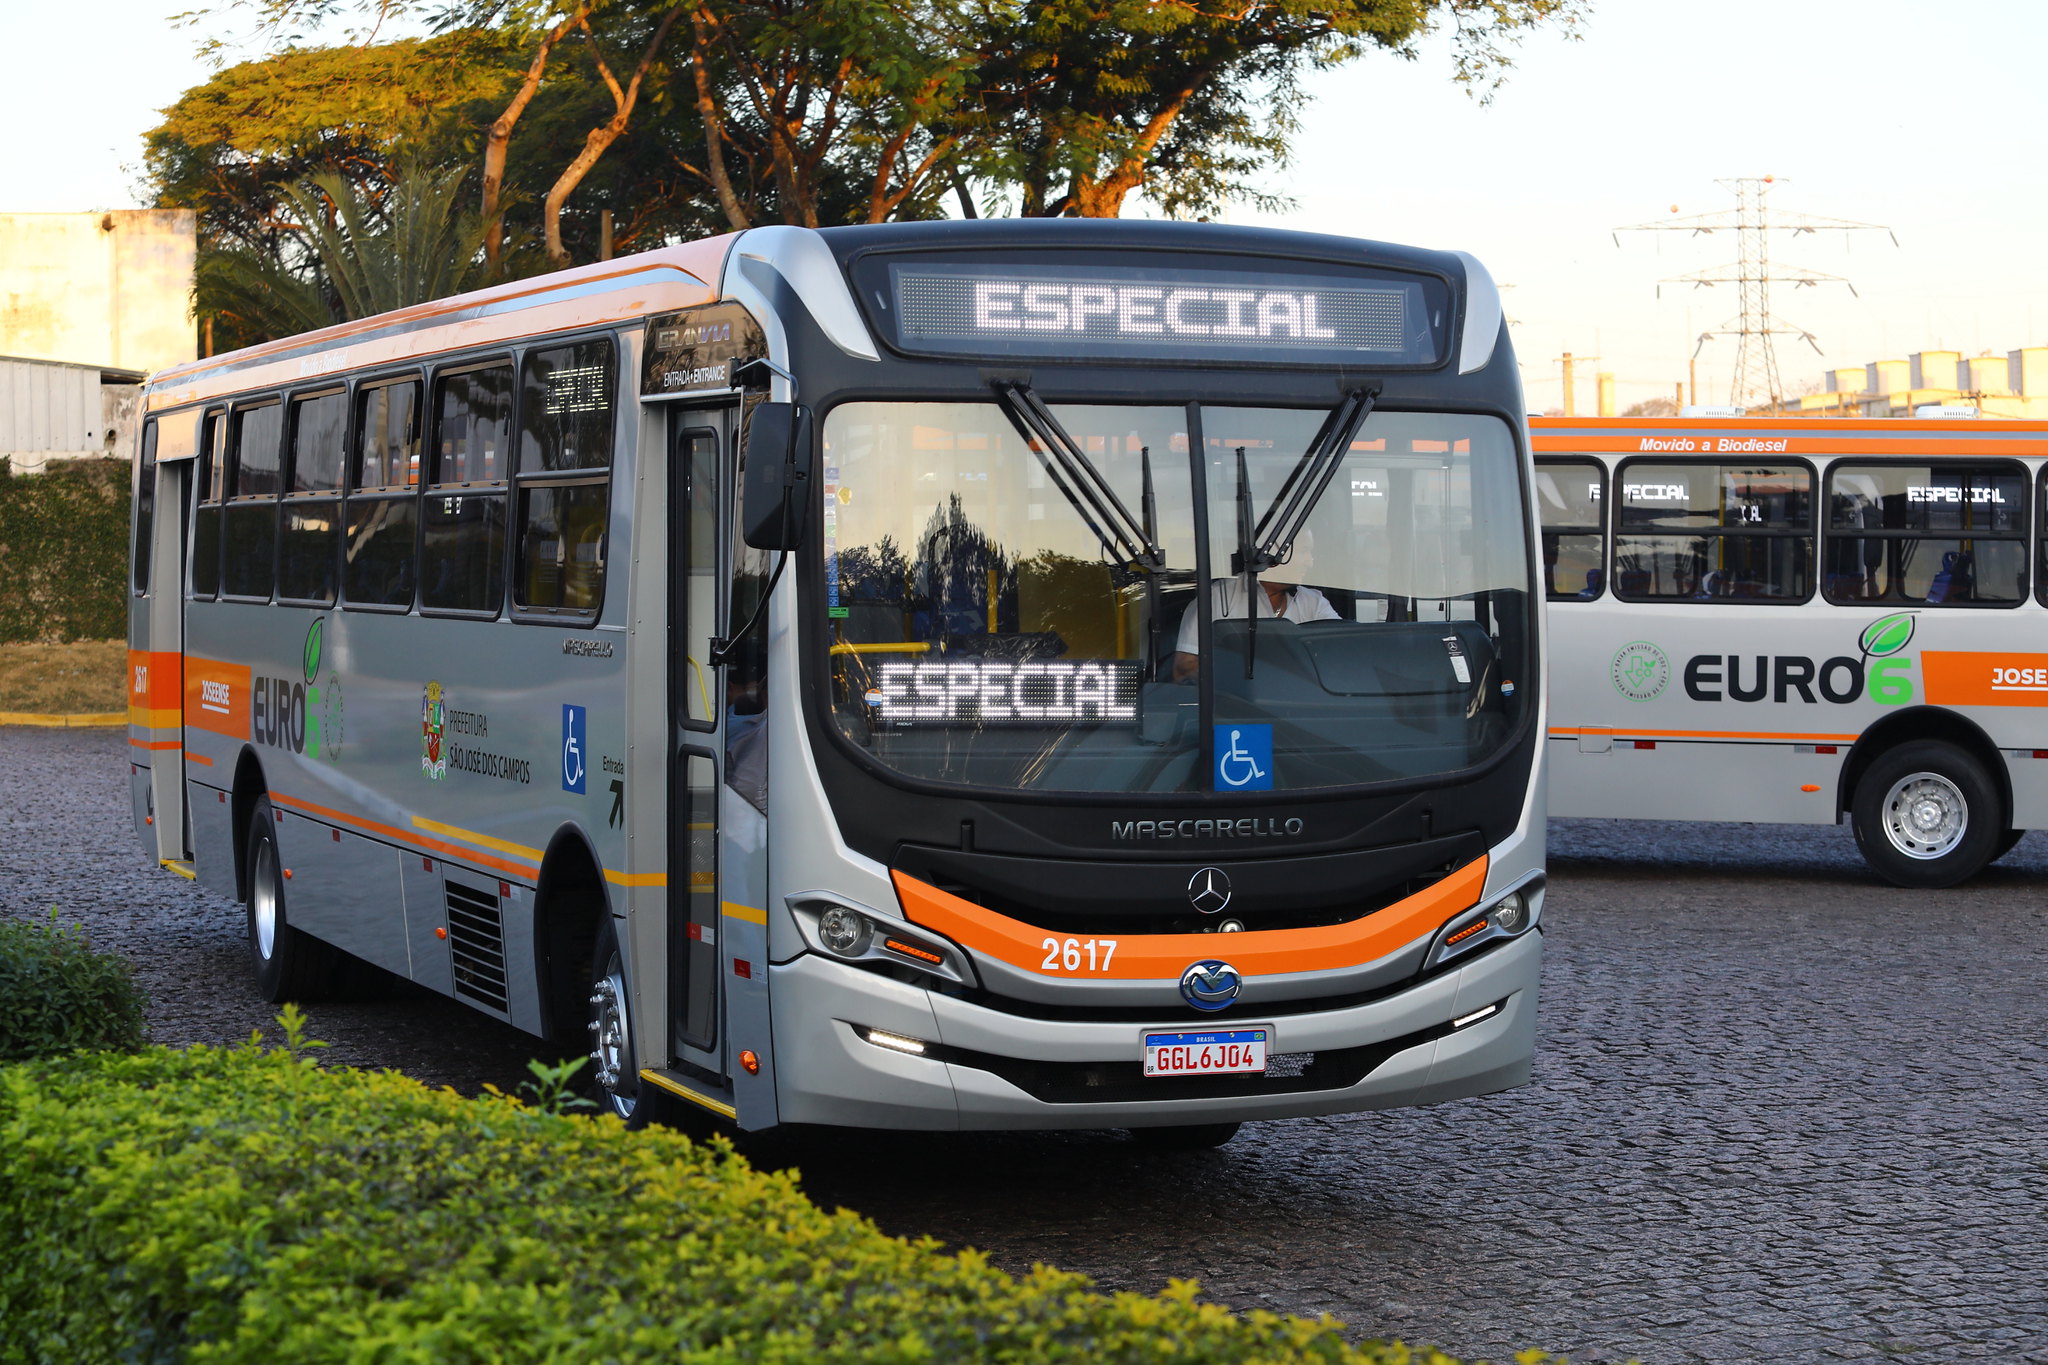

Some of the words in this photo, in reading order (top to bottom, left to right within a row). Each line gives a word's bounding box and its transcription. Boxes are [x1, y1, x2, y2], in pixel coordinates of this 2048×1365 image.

[973, 280, 1336, 339] ESPECIAL
[663, 369, 691, 388] ENTRADA
[693, 365, 726, 384] ENTRANCE
[1639, 437, 1695, 452] Movido
[1701, 440, 1711, 451] a
[1717, 438, 1788, 453] Biodiesel
[202, 680, 230, 706] JOSEENSE
[881, 662, 1135, 717] ESPECIAL
[450, 709, 488, 738] PREFEITURA
[450, 742, 464, 770] SÃO
[464, 746, 481, 774] JOSÉ
[482, 752, 497, 777] DOS
[499, 755, 531, 785] CAMPOS
[602, 755, 624, 775] Entrada
[1111, 817, 1304, 840] MASCARELLO
[1040, 937, 1118, 972] 2617
[1157, 1044, 1254, 1071] GGL6J04
